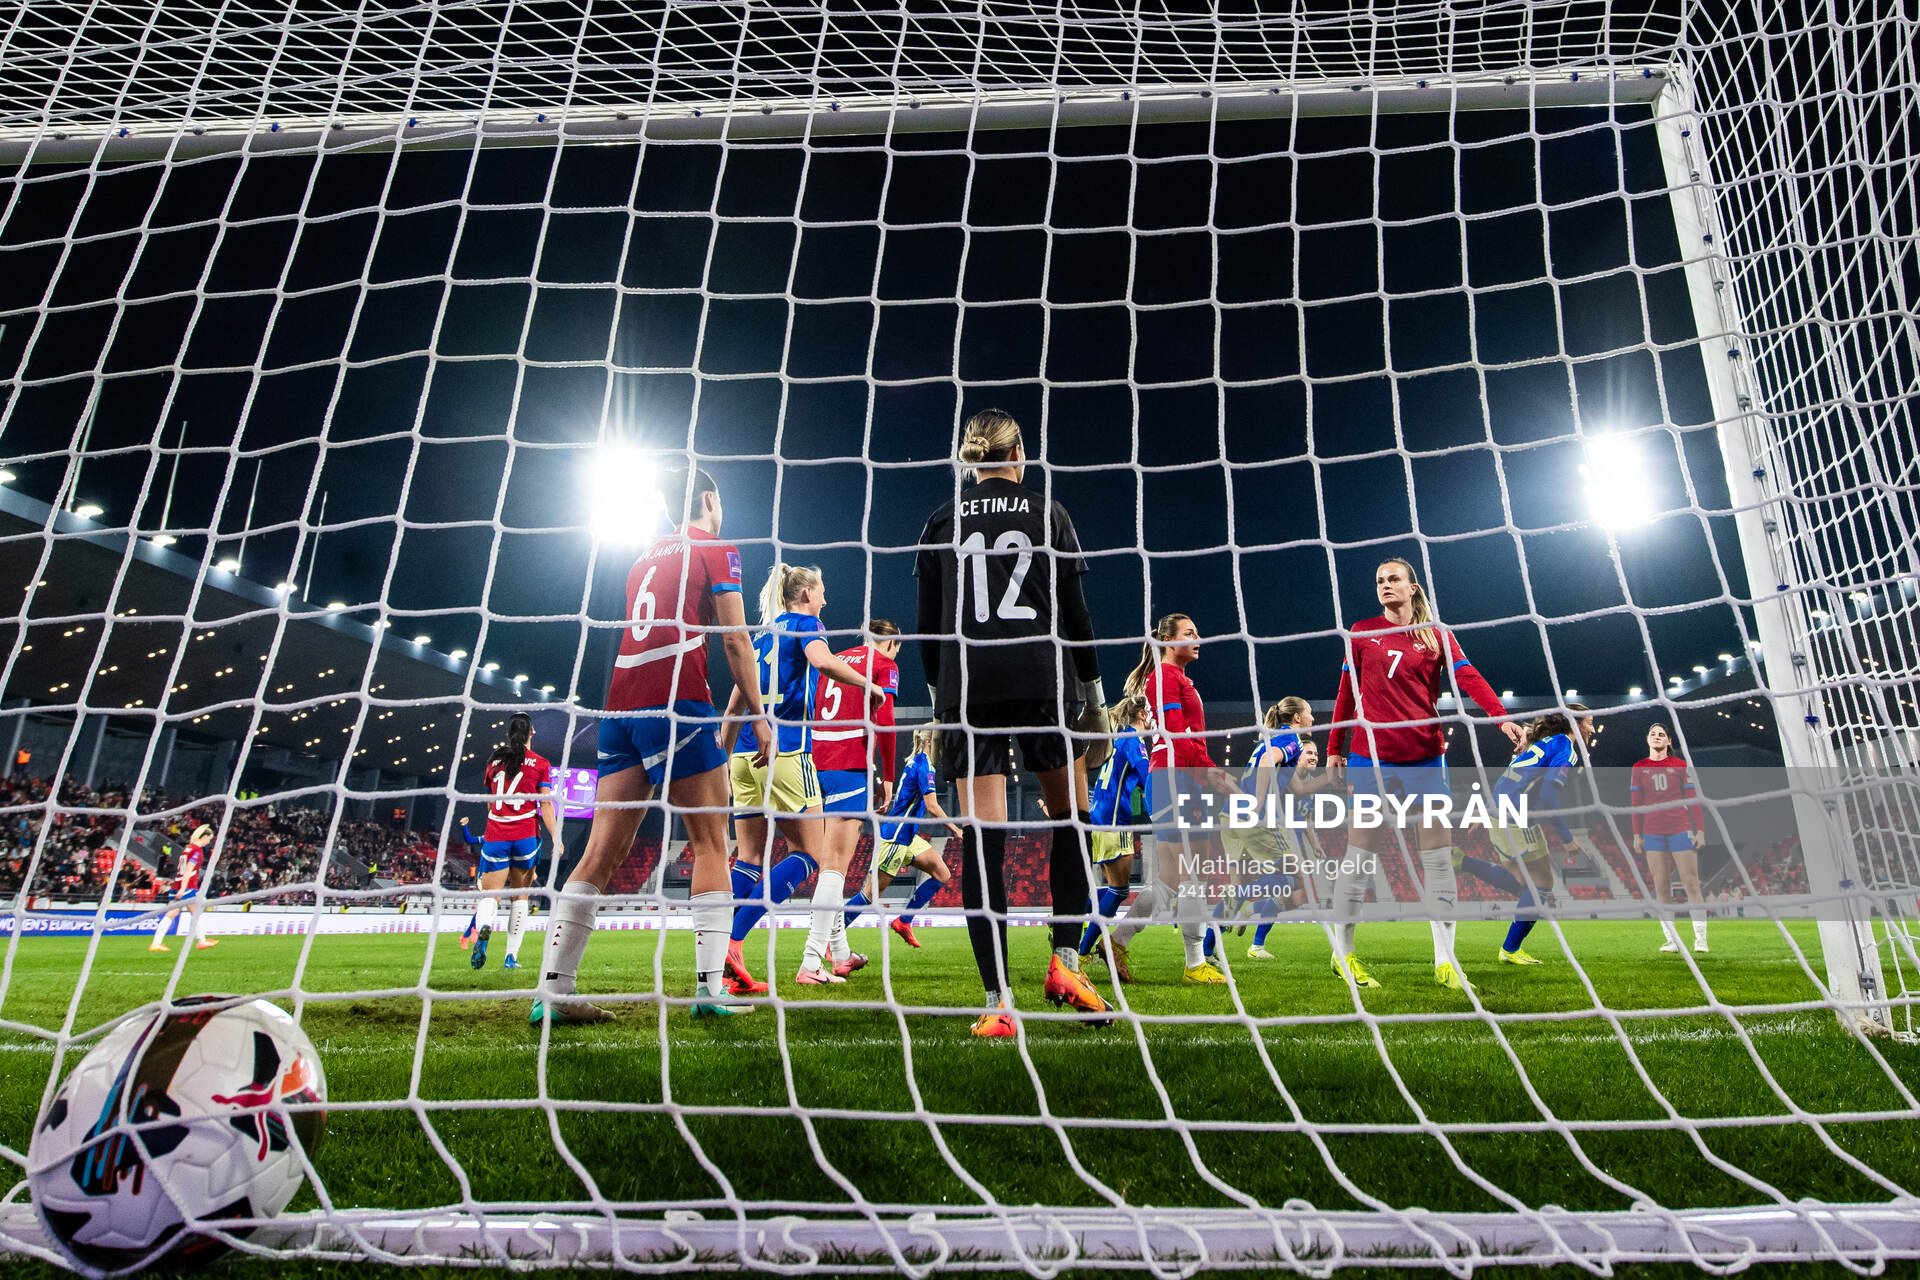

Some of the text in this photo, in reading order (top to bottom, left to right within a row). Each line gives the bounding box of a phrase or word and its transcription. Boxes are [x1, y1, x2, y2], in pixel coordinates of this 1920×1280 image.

[960, 497, 1030, 517] CETINJA
[959, 530, 1037, 623] 12
[631, 565, 657, 642] 6
[1387, 649, 1404, 679] 7
[821, 678, 843, 721] 5
[493, 770, 525, 811] 14
[1651, 773, 1668, 791] 10
